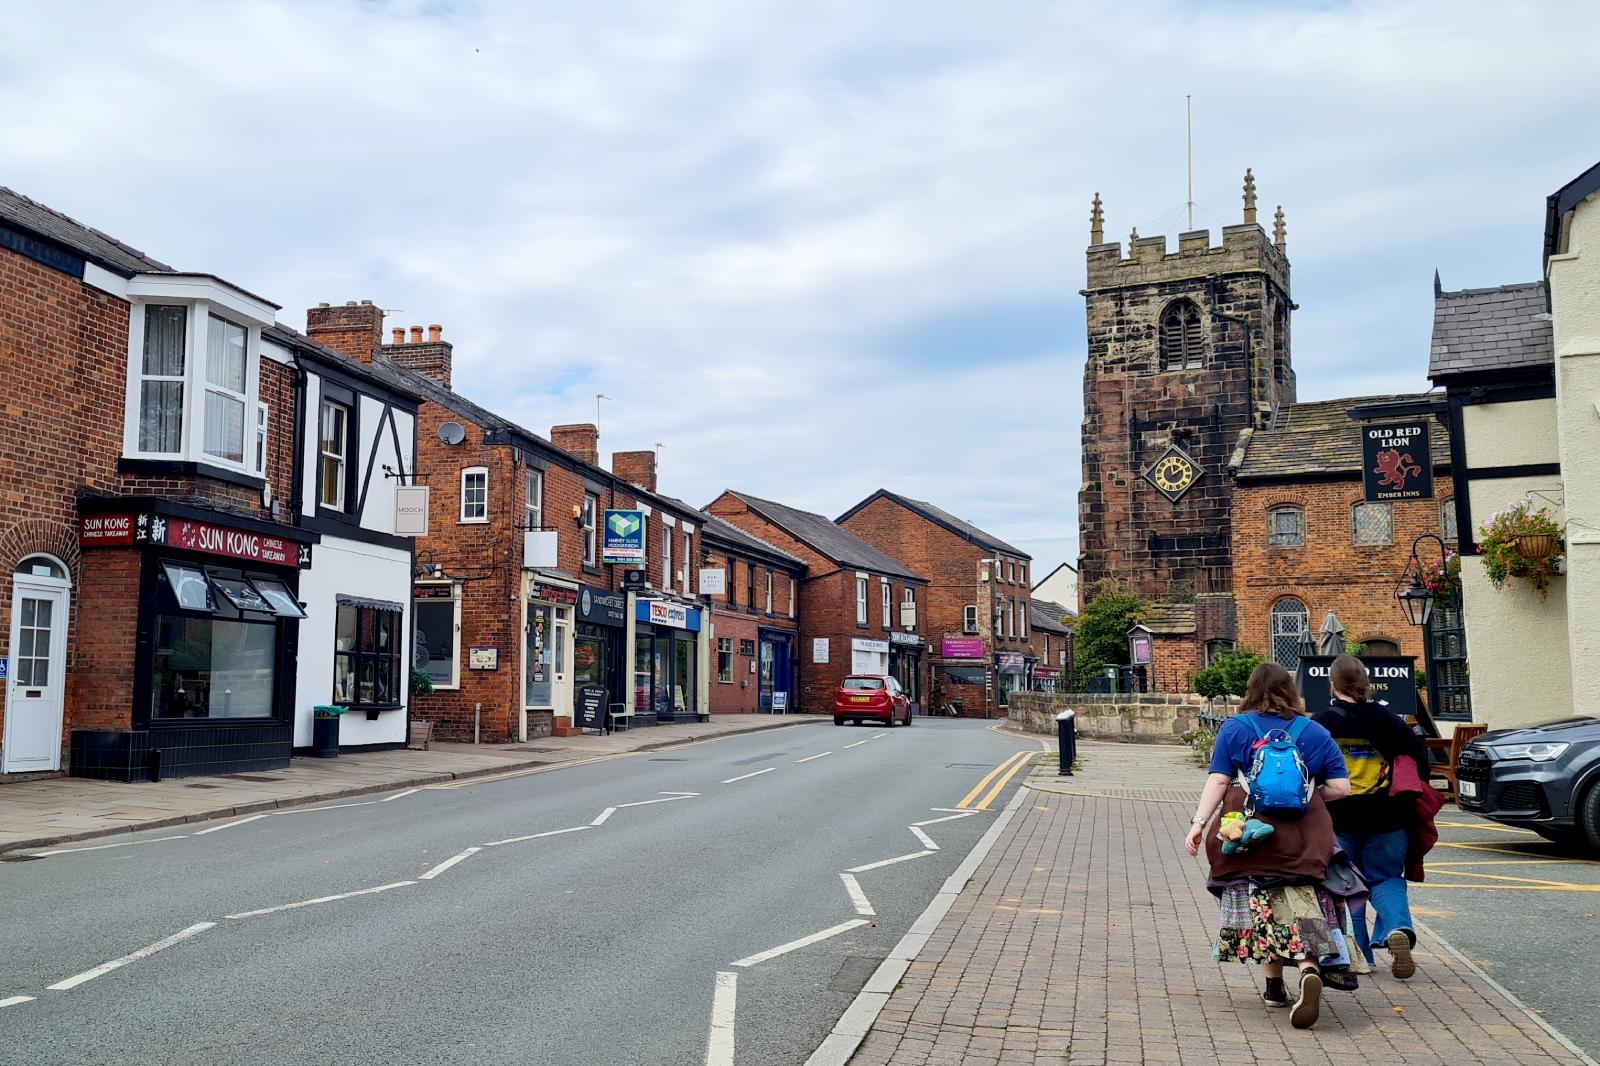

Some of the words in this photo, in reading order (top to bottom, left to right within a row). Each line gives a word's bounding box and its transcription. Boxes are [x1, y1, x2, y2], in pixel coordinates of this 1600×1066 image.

[1369, 429, 1393, 438] OLD
[1396, 427, 1421, 436] RED
[1382, 438, 1410, 447] LION
[84, 518, 102, 530] SUN
[104, 518, 129, 529] KONG
[199, 526, 224, 551] SUN
[226, 531, 259, 557] KONG
[263, 538, 283, 550] CHINESE
[262, 549, 285, 562] TAKEAWAY
[652, 604, 667, 617] TESCO
[1374, 667, 1408, 678] LION
